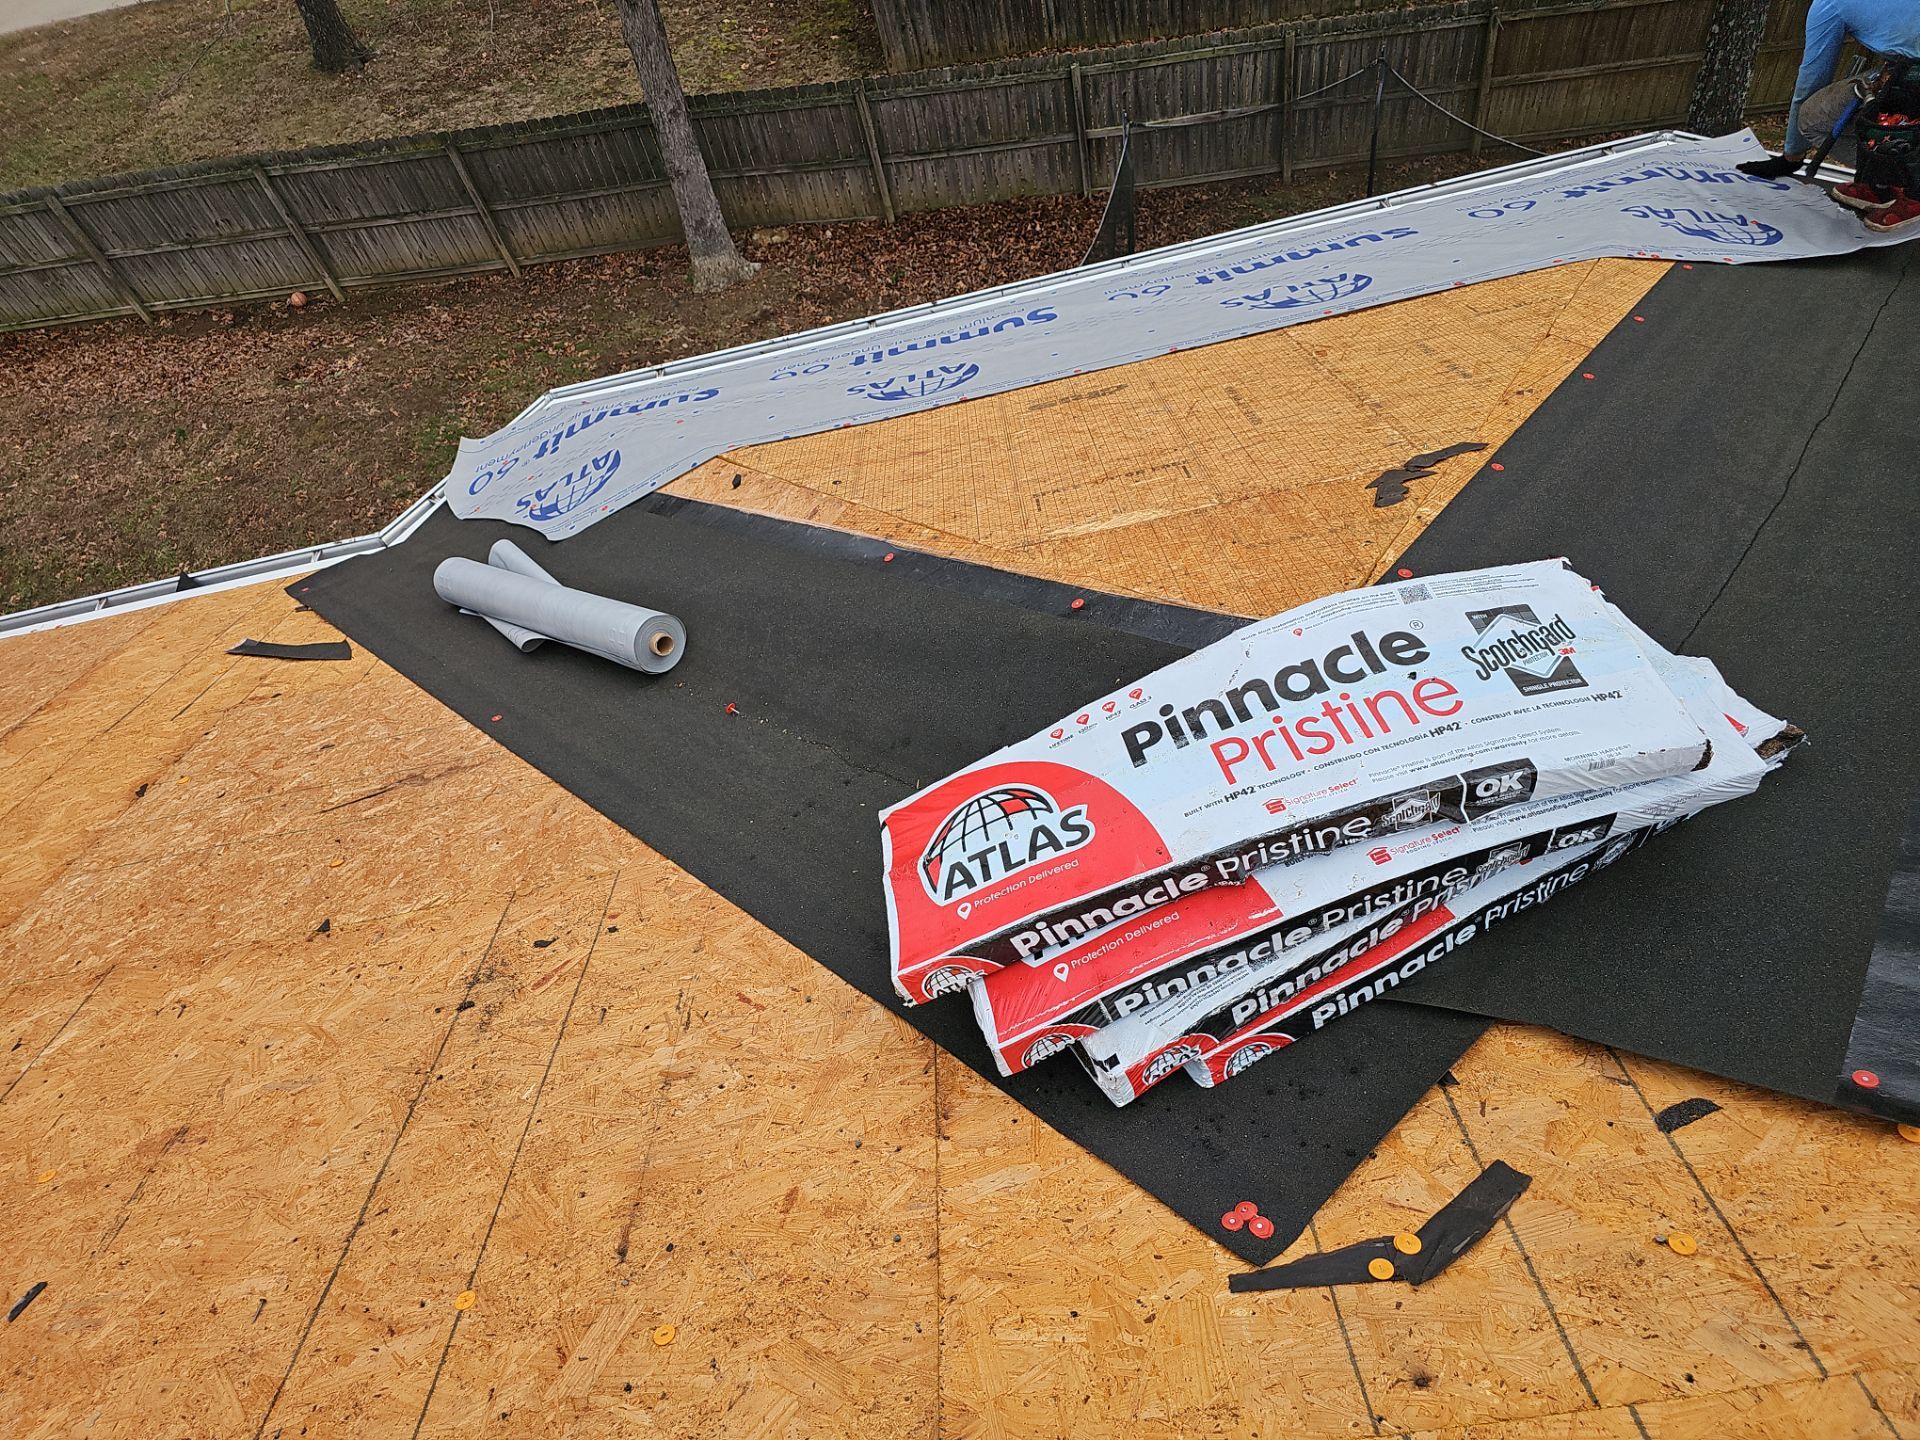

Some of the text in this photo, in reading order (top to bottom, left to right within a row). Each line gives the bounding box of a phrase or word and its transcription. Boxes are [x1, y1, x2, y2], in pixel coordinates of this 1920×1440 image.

[1468, 200, 1537, 219] 60
[1620, 205, 1749, 228] ATLAS
[1193, 227, 1419, 285] Summit
[1219, 273, 1348, 309] ATLAS
[849, 306, 1058, 367] Summit
[847, 361, 967, 396] ATLAS
[532, 389, 720, 461] Summit
[468, 456, 520, 496] 60
[515, 451, 612, 515] ATLAS
[1461, 613, 1576, 681] Scotchgard
[1558, 647, 1576, 656] 3M
[1470, 710, 1512, 725] CONSTRUIT
[1513, 706, 1531, 717] AVEC
[1531, 704, 1542, 712] LA
[1591, 690, 1623, 703] HP42
[1523, 679, 1582, 693] SHINGLE PROTECTOR
[1210, 677, 1463, 785] Pristine
[1314, 752, 1363, 771] CONSTRUIDO
[1363, 747, 1380, 756] CON
[1429, 721, 1463, 738] HP42
[1183, 770, 1306, 818] BUILT WITH HP42 TECHNOLOGY
[1284, 777, 1359, 806] Signature Select
[1475, 771, 1524, 798] OK
[943, 808, 1091, 901] ATLAS
[1215, 815, 1372, 880] Pristine
[1389, 834, 1431, 856] Signature
[1431, 826, 1461, 841] Select
[1558, 828, 1601, 848] OK
[973, 859, 1080, 908] Protection Delivered
[1322, 866, 1467, 932] Pristine
[1485, 863, 1591, 932] Pristine
[1070, 911, 1180, 970] Protection Delivered
